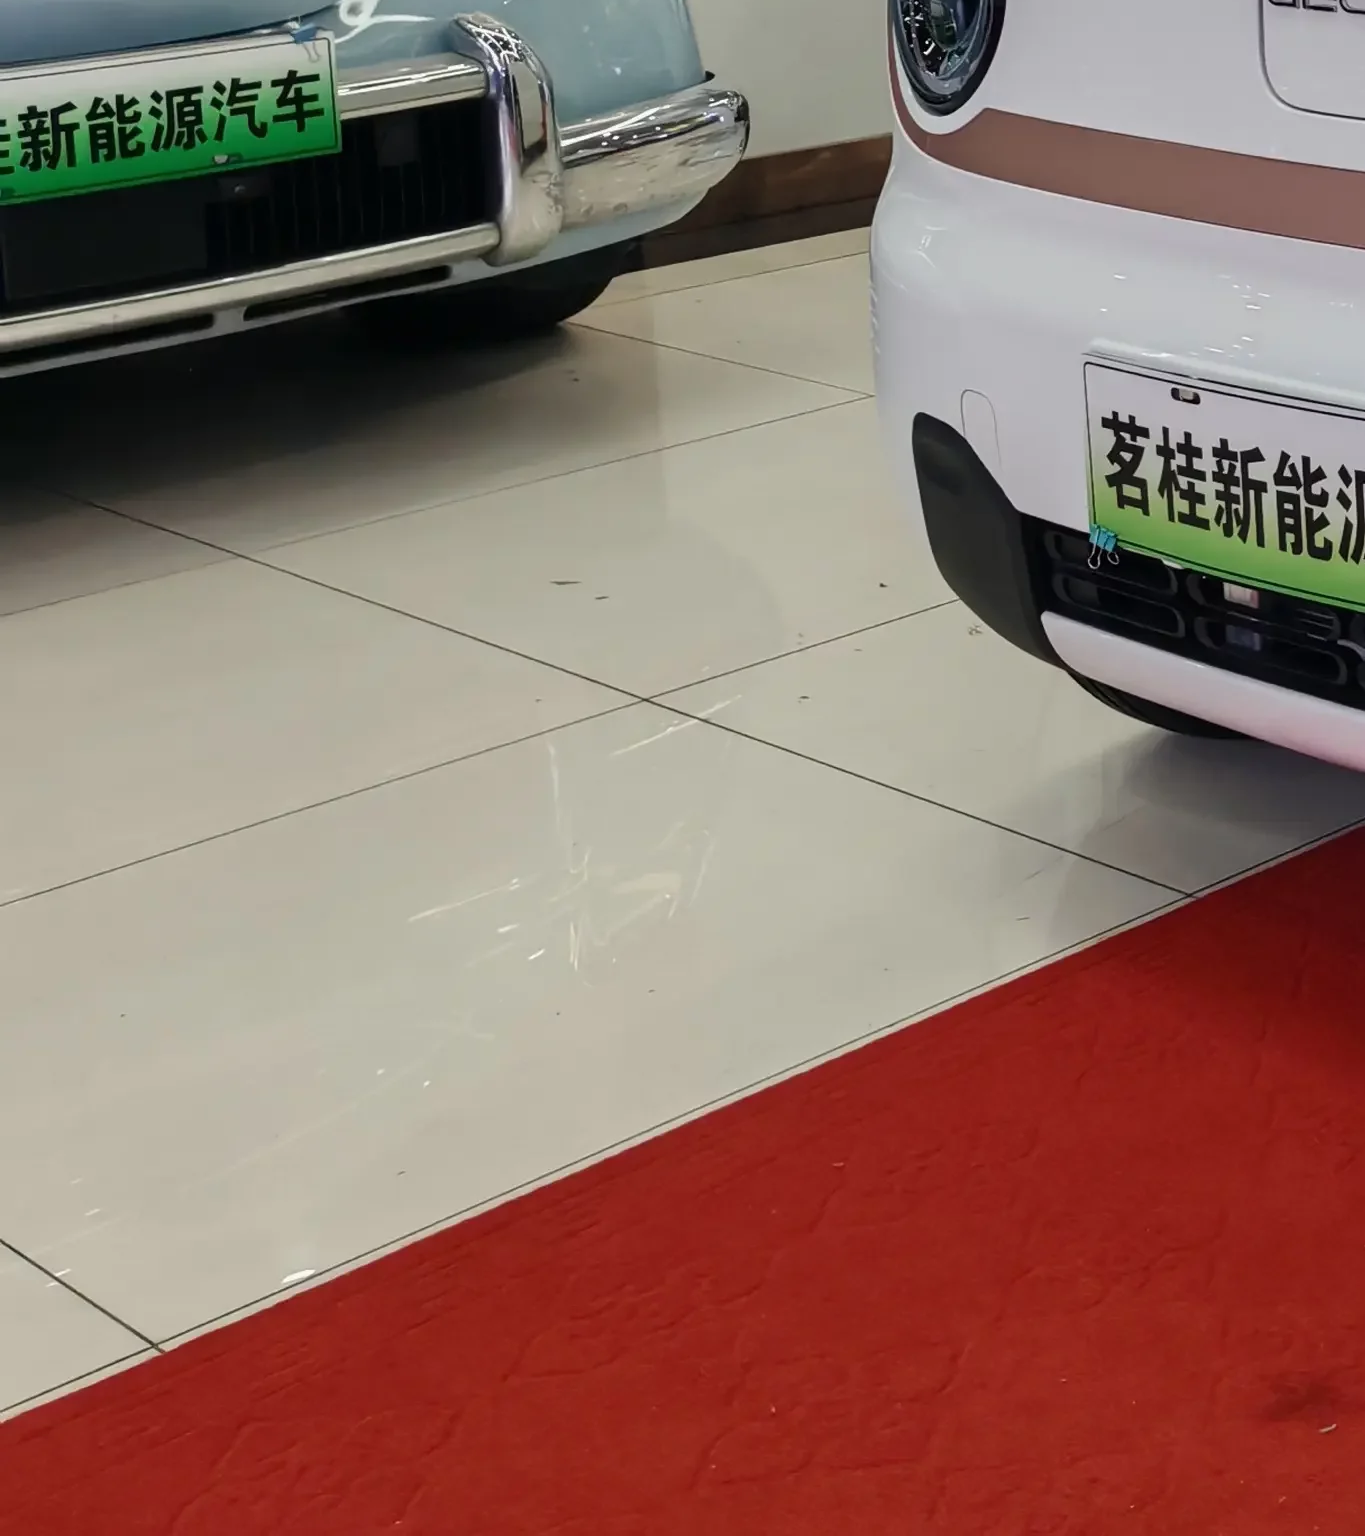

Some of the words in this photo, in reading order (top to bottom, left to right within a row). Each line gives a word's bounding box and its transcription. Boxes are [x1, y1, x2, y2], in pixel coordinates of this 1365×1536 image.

[0, 68, 325, 176] 新能源汽车
